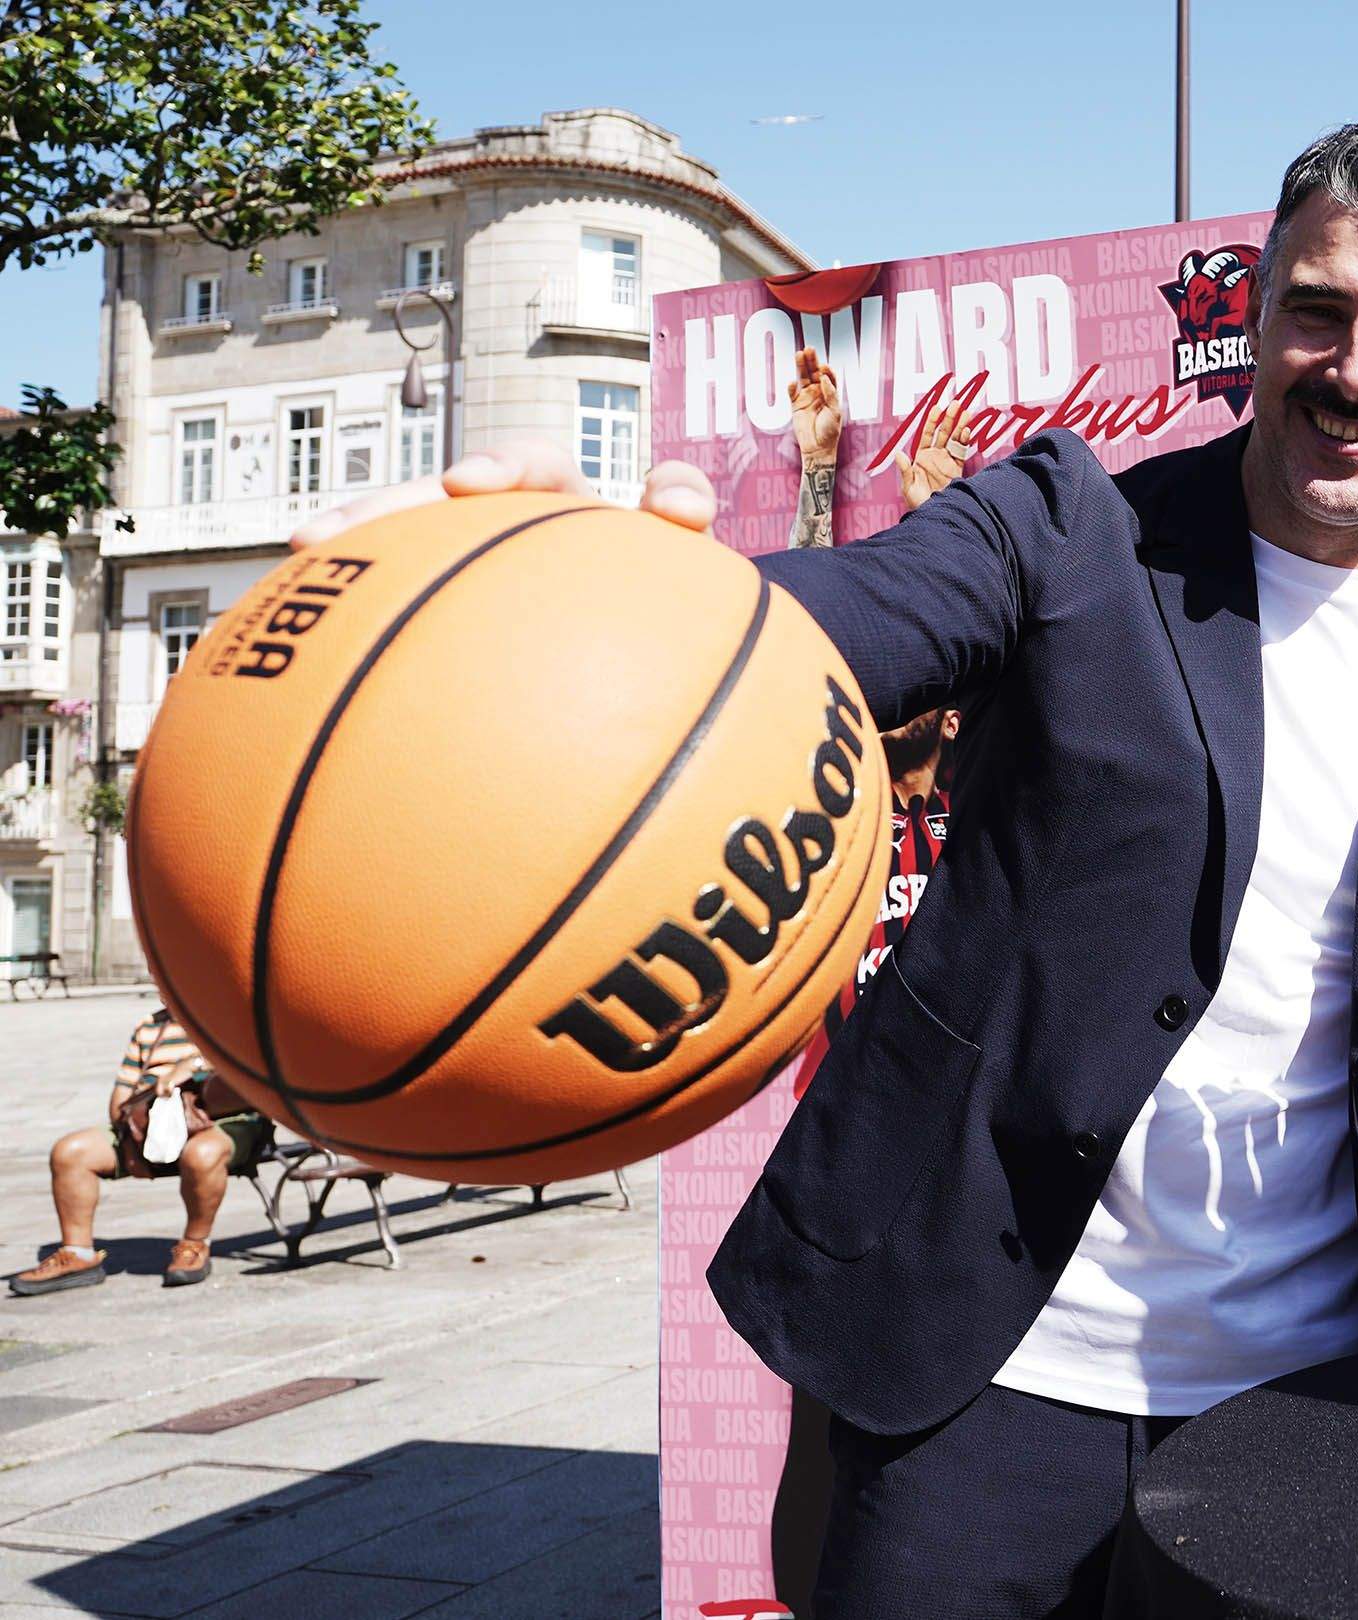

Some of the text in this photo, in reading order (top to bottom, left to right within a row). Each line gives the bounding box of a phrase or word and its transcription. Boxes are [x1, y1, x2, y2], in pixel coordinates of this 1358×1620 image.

[685, 274, 1073, 438] HOWARD
[1177, 335, 1257, 381] BASKO
[865, 363, 1191, 472] Markus
[235, 557, 374, 678] FIBA
[534, 674, 864, 1072] Wilson
